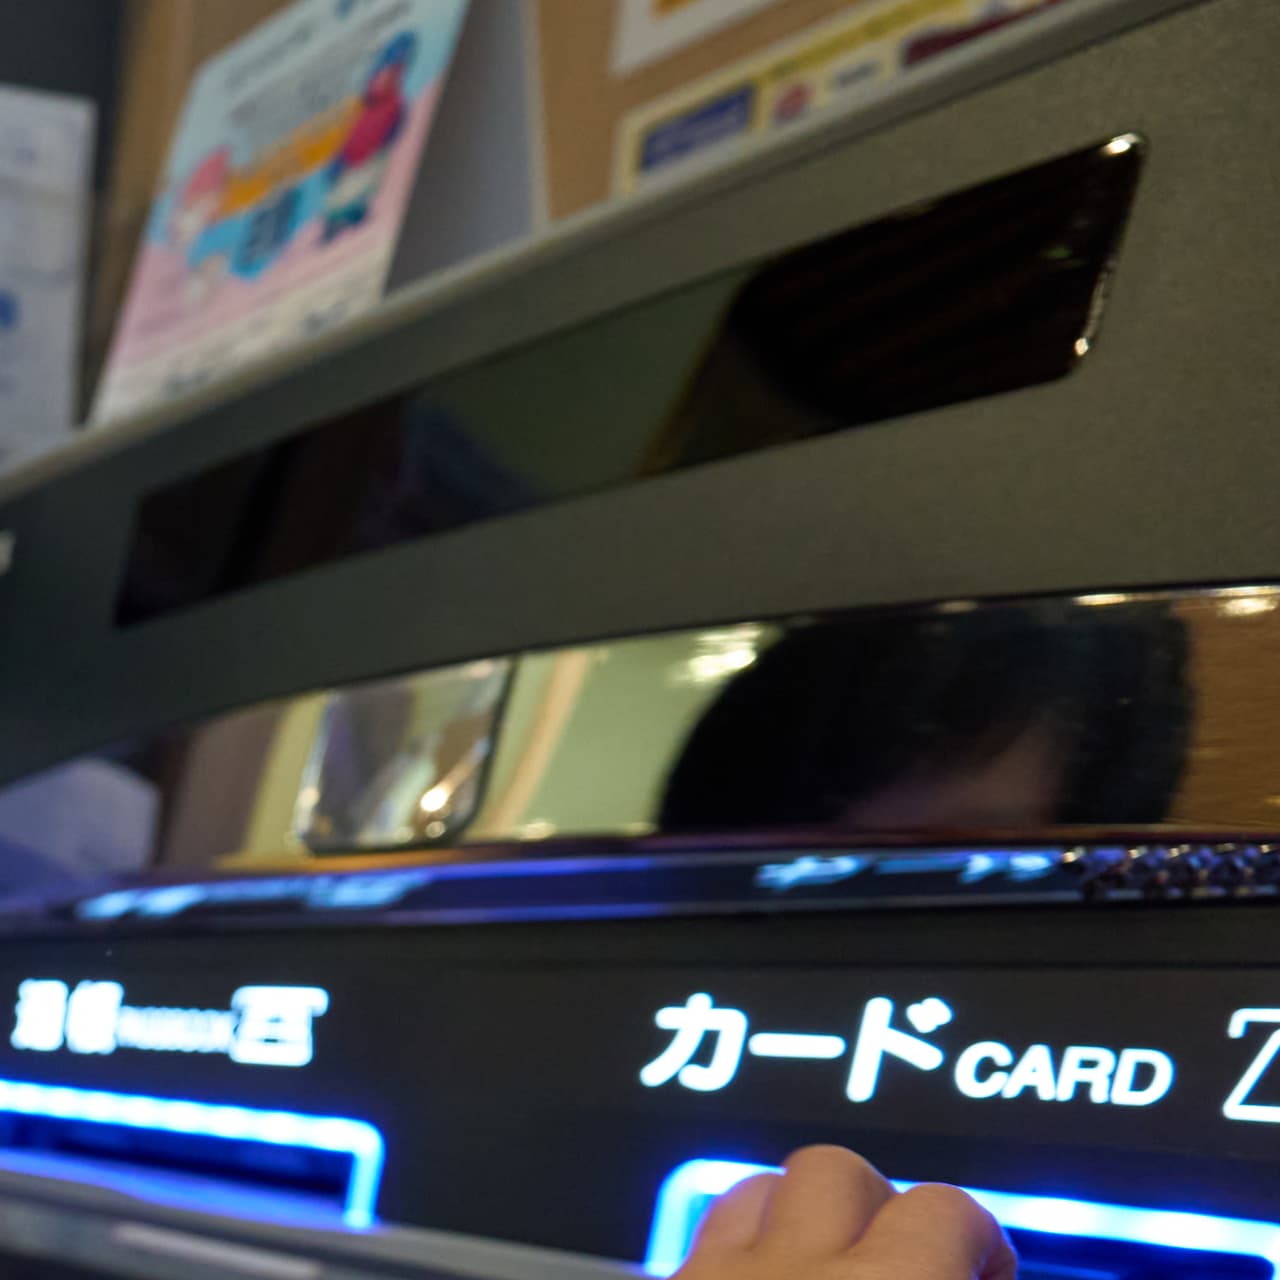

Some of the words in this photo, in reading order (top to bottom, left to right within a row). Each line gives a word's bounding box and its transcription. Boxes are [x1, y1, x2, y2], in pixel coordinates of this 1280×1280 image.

[639, 992, 951, 1102] カード
[953, 1040, 1173, 1106] CARD
